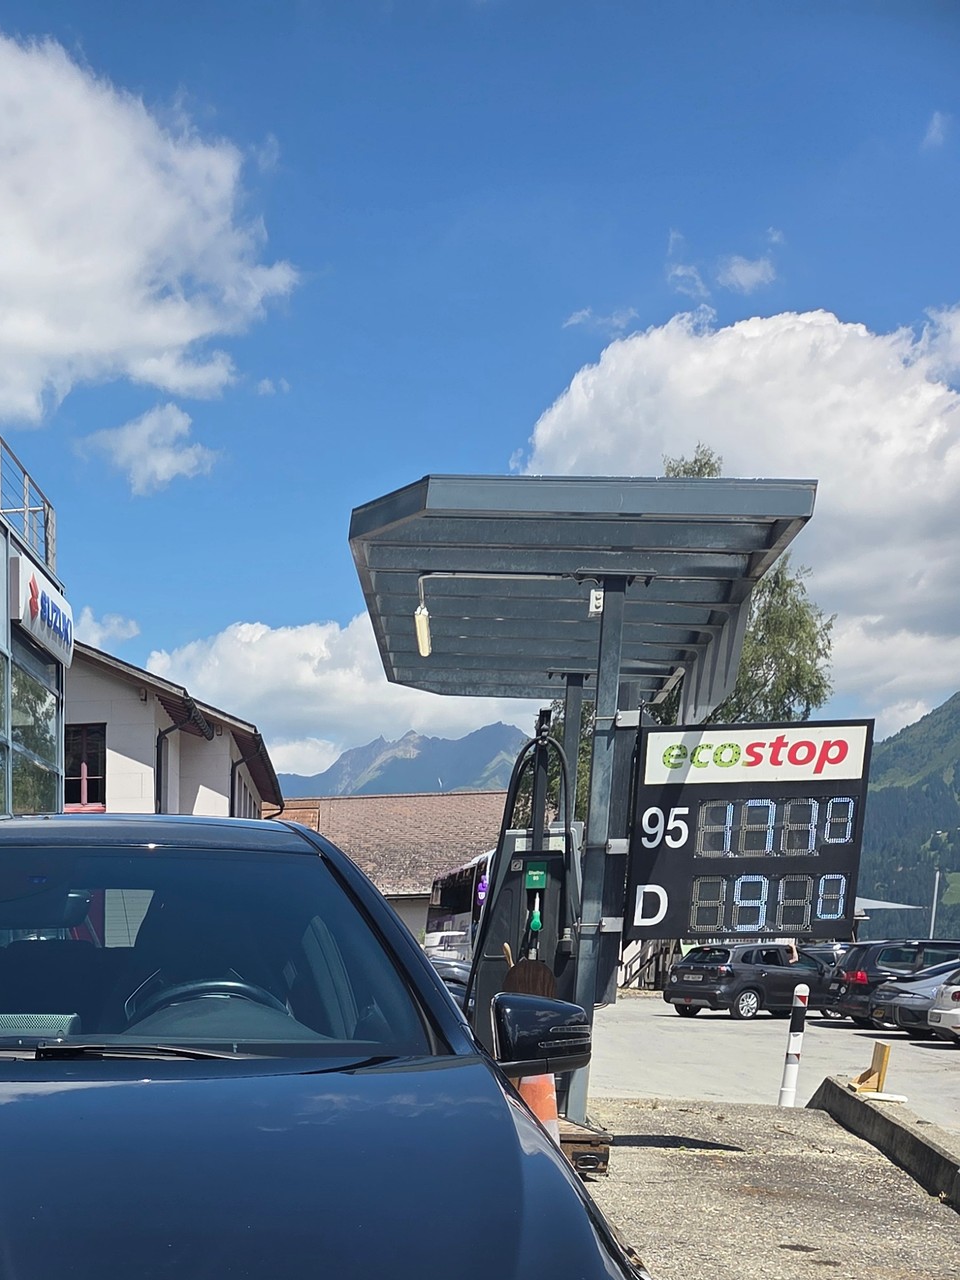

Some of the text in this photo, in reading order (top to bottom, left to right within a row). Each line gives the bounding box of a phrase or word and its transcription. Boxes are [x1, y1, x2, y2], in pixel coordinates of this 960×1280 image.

[40, 590, 73, 647] SUZUKI
[662, 735, 849, 774] ecostop
[641, 807, 689, 848] 95
[633, 885, 668, 926] D
